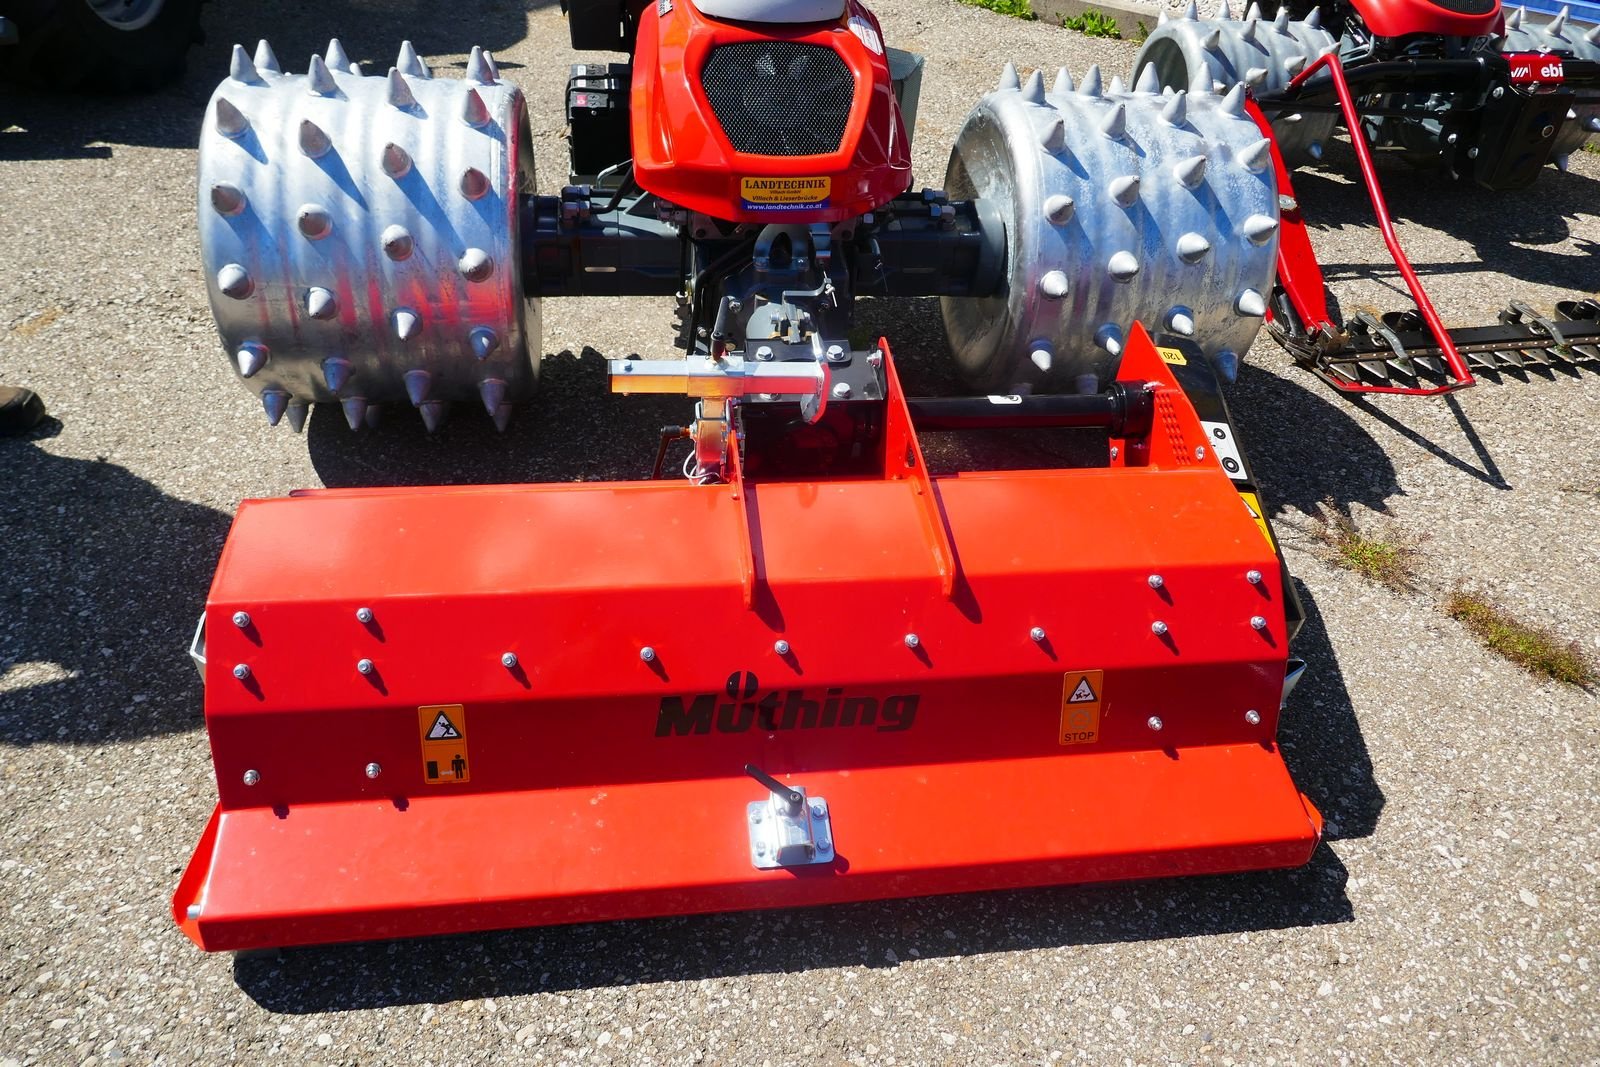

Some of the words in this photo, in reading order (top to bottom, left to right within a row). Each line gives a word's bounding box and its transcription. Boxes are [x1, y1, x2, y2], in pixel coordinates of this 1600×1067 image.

[745, 180, 826, 189] LANDTECHNIK
[654, 670, 921, 738] Müthing
[1064, 731, 1095, 742] STOP
